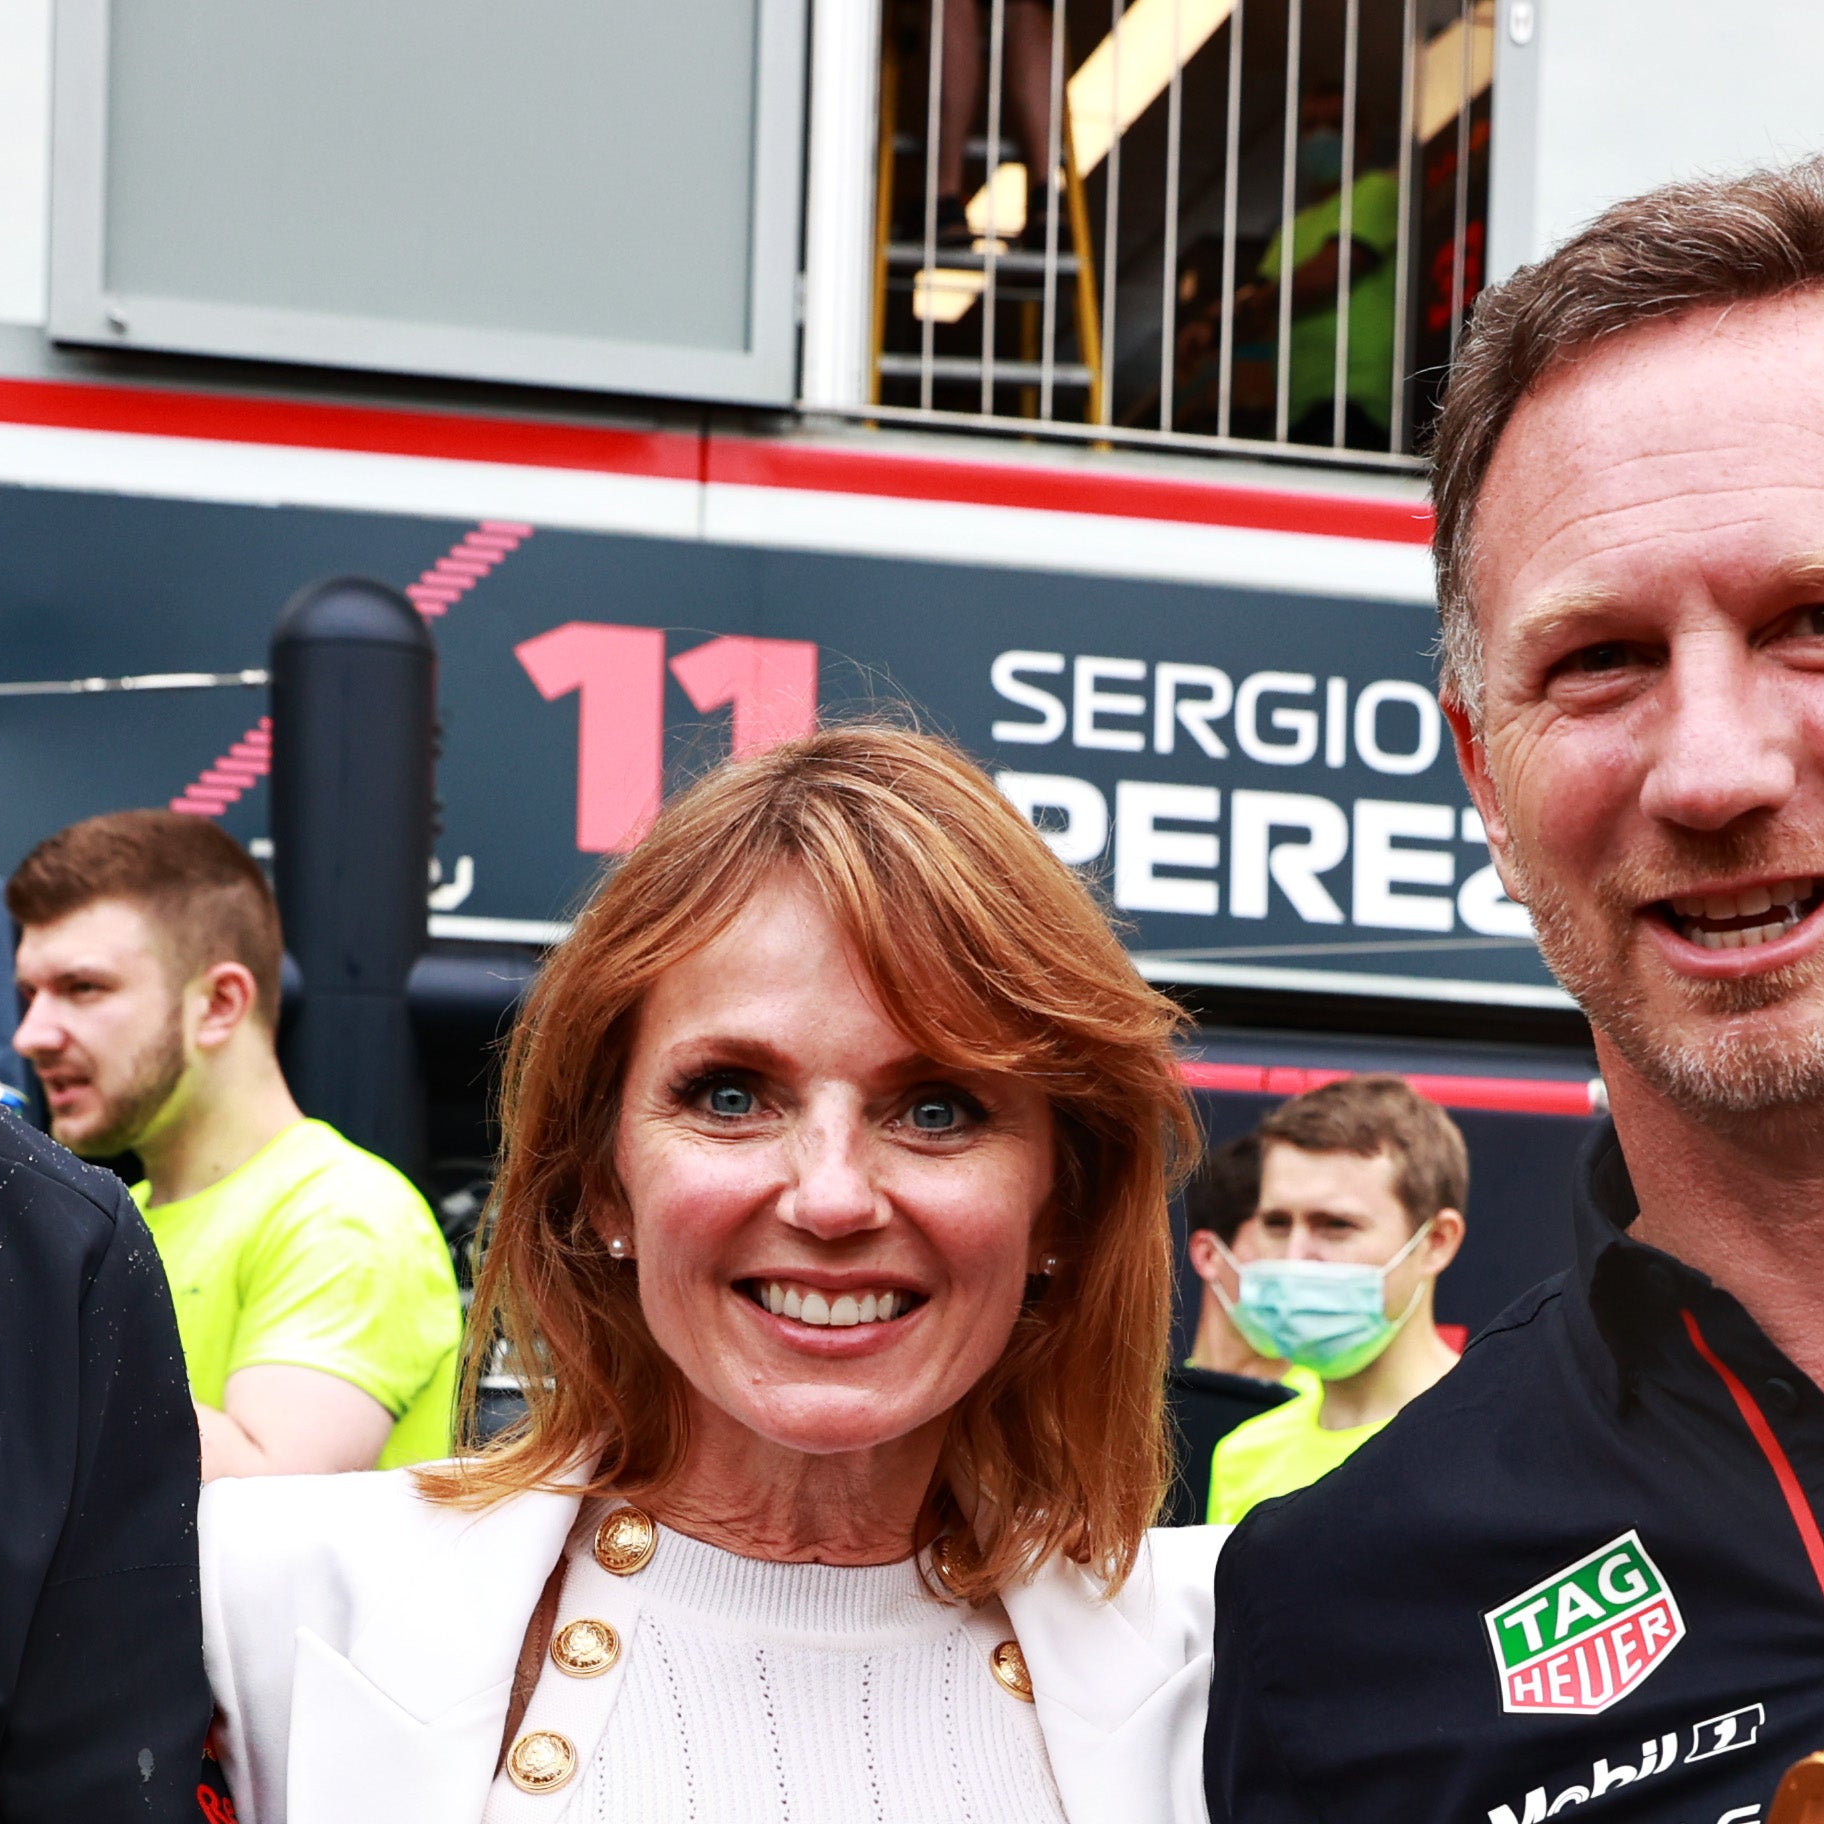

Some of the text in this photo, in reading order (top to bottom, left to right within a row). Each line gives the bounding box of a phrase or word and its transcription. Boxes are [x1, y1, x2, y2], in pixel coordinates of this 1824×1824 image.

[989, 648, 1443, 776] SERGIO
[1502, 1551, 1649, 1653] TAG
[1512, 1609, 1671, 1707] HEUER
